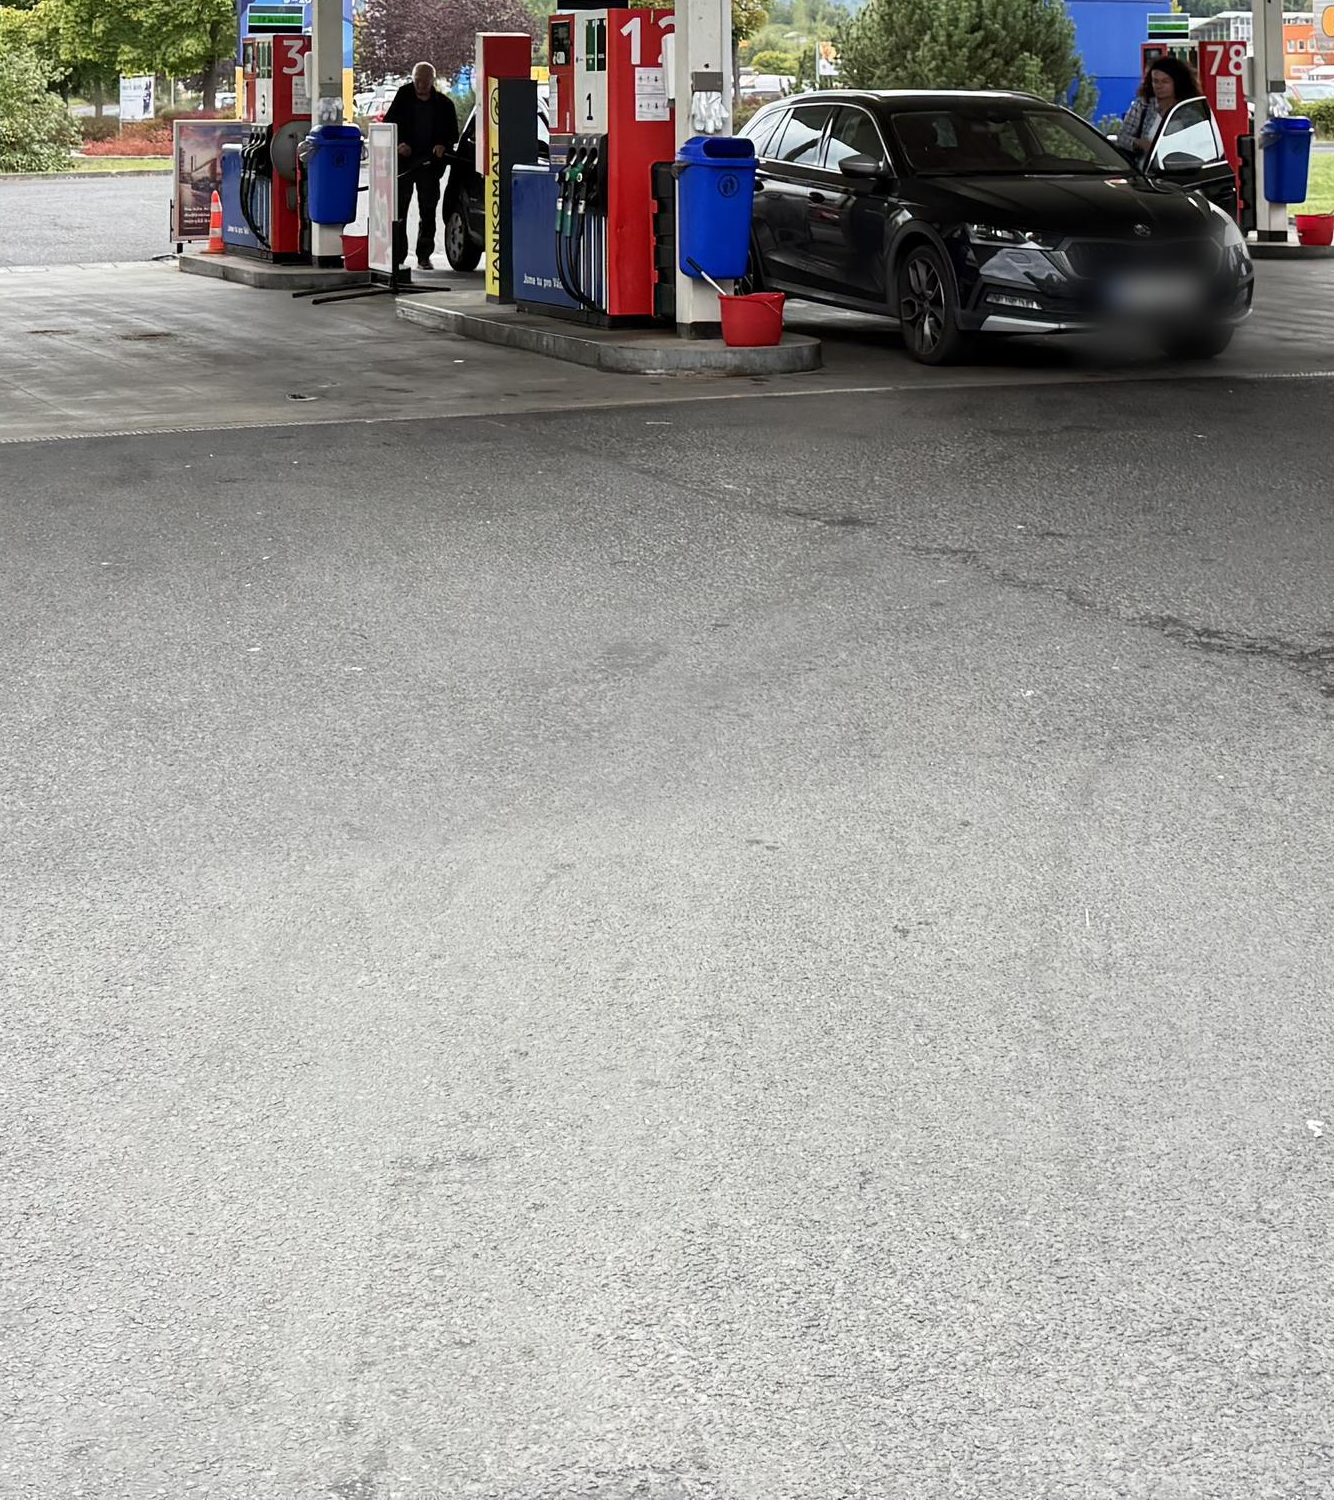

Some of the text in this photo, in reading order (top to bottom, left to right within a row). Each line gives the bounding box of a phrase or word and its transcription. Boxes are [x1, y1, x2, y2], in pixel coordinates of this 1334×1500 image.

[282, 40, 304, 75] 3
[261, 94, 268, 115] 3
[586, 93, 594, 121] 1
[491, 148, 500, 285] TANKOMAT
